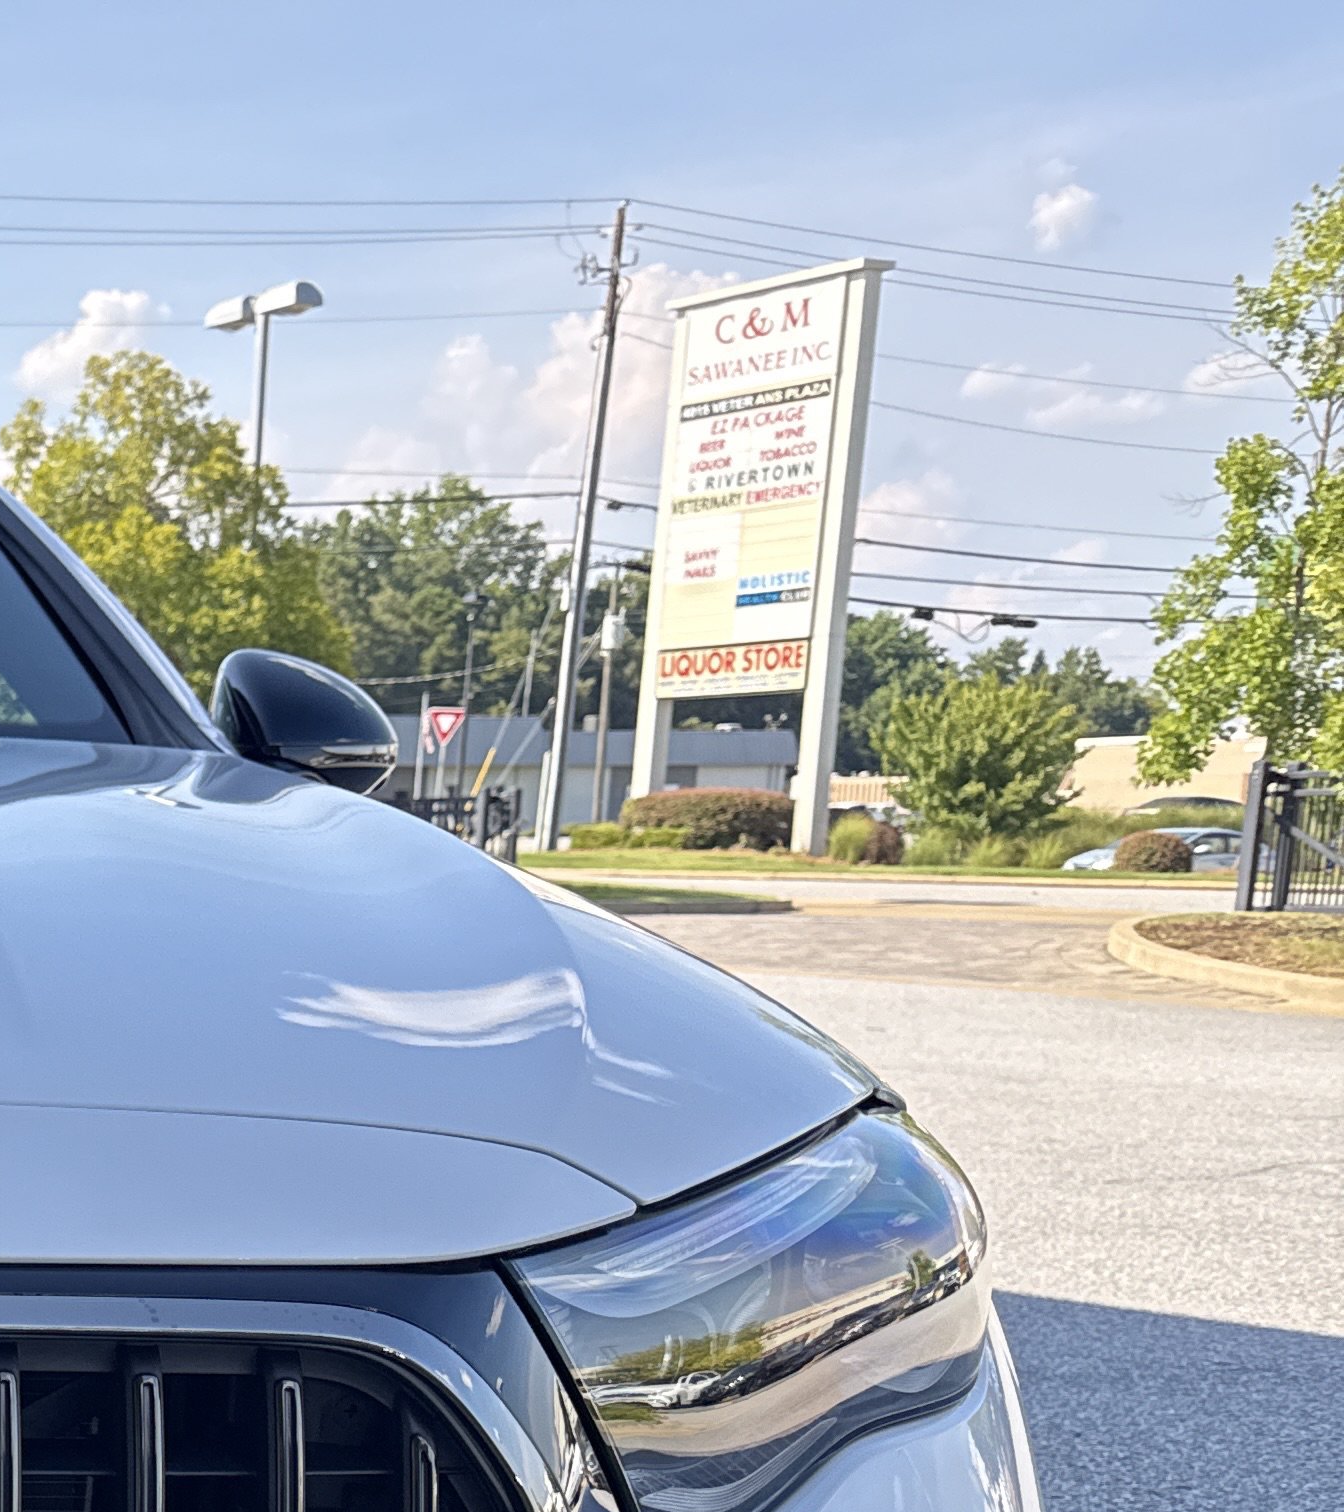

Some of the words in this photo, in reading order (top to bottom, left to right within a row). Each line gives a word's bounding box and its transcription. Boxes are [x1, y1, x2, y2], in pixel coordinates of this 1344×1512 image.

[715, 314, 735, 344] C
[742, 307, 774, 339] &
[781, 297, 812, 332] M
[688, 350, 787, 386] SAWANEE
[784, 382, 830, 401] PLAZA
[711, 418, 728, 435] EZ
[774, 425, 806, 441] WINE
[699, 439, 726, 454] BEER
[760, 441, 817, 462] TOBACCO
[705, 460, 815, 490] RIVERTOWN
[672, 492, 743, 515] VETERINARY
[745, 481, 823, 505] EMERGENCY
[738, 570, 810, 589] HOLISTIC
[661, 650, 736, 678] LIQUOR
[742, 644, 804, 673] STORE
